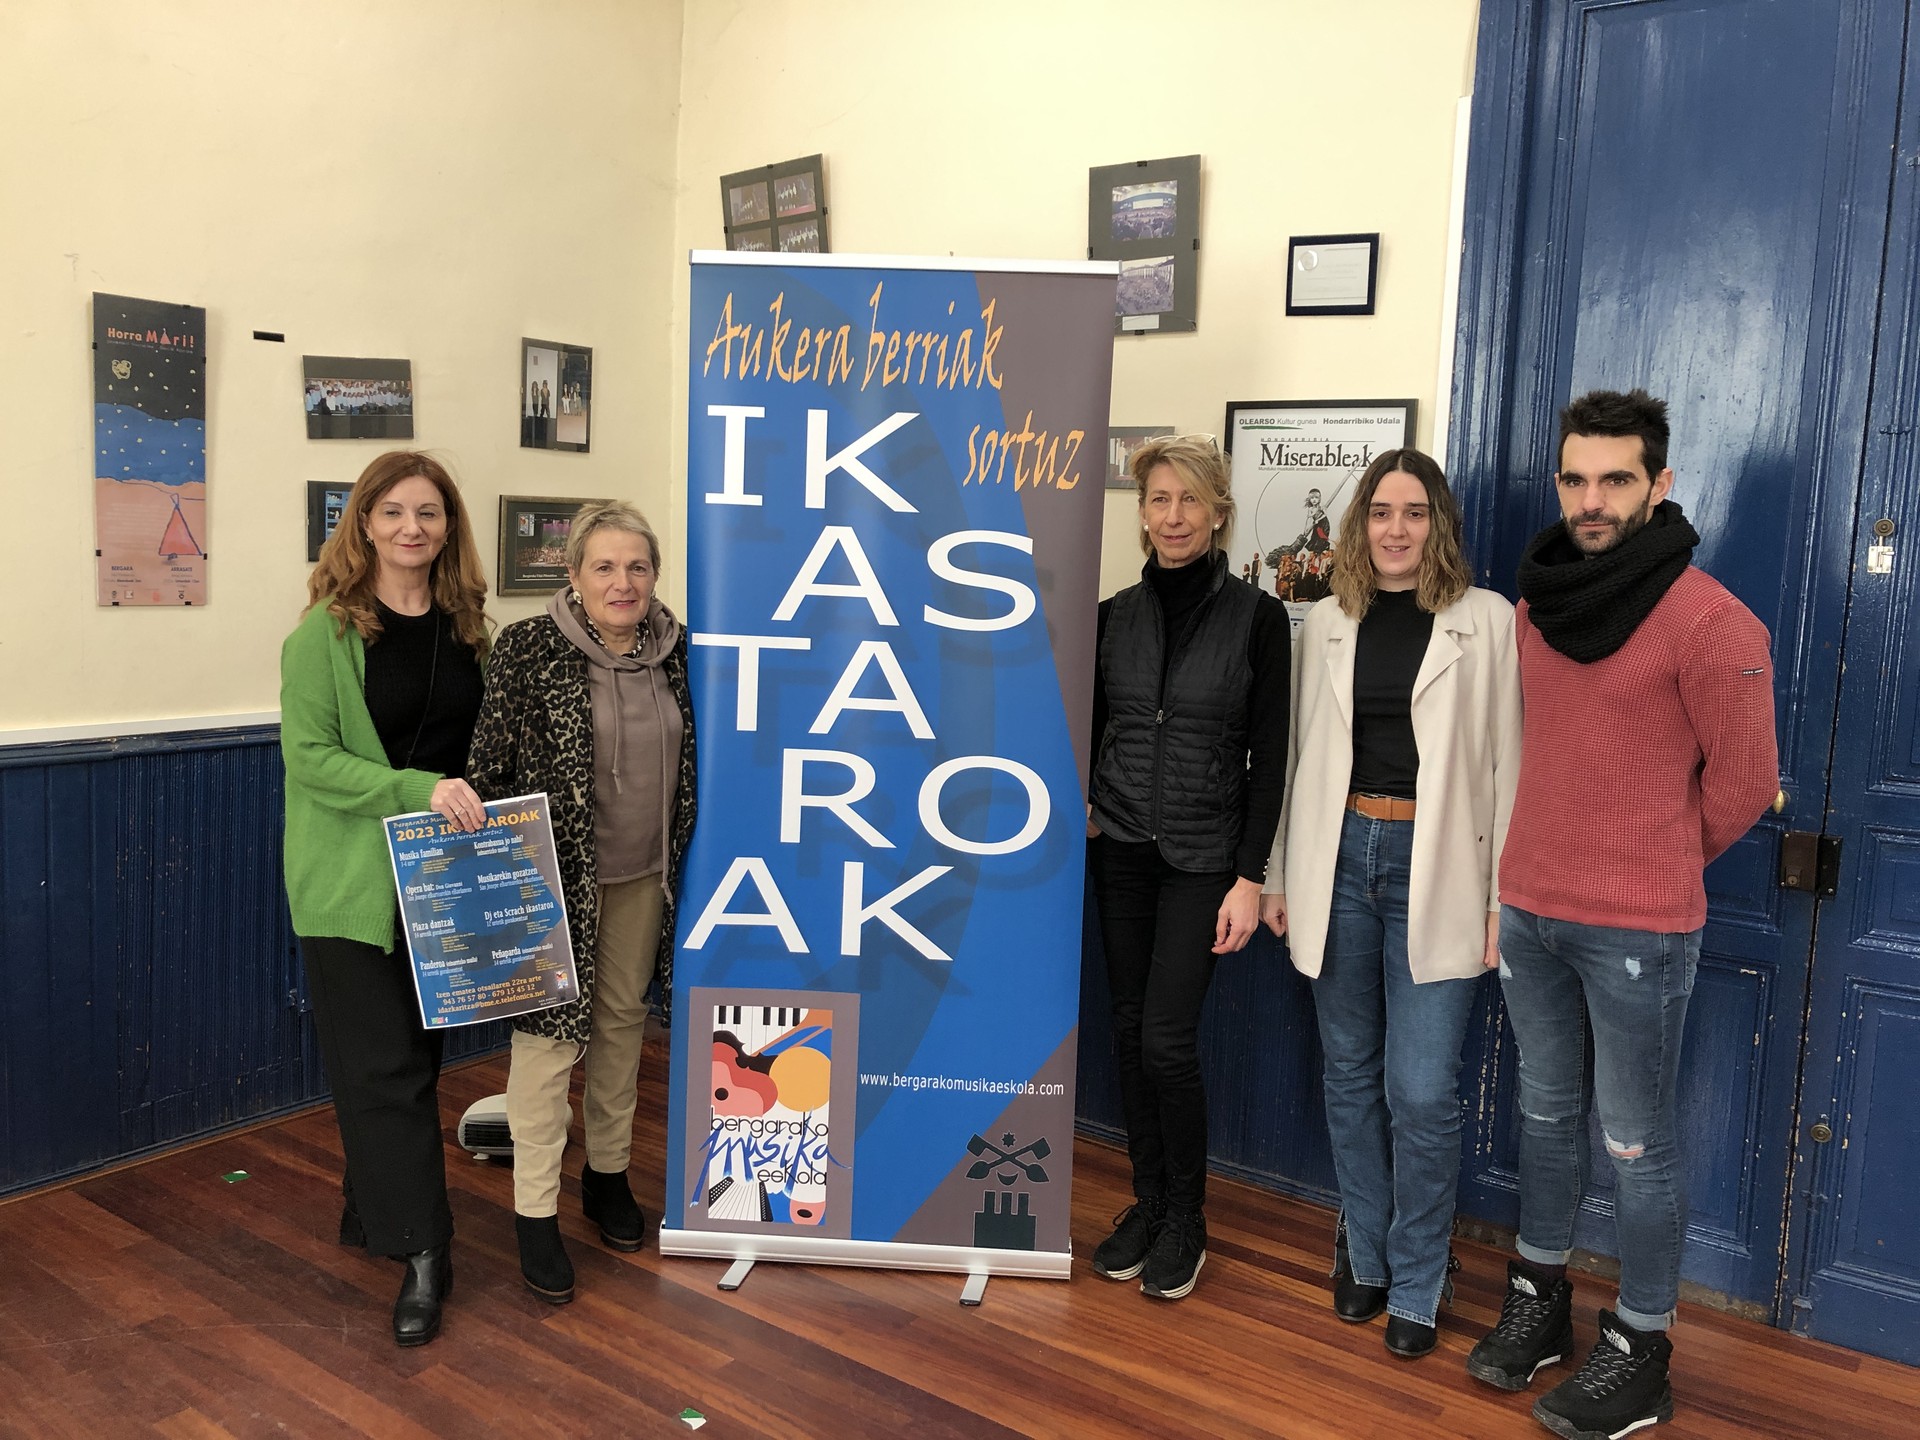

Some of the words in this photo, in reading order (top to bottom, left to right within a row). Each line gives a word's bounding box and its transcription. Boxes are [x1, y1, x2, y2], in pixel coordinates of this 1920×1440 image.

[107, 327, 142, 341] Horra
[704, 292, 854, 386] Aukera
[861, 281, 1003, 392] berriak
[1323, 417, 1374, 425] Hondarribiko
[1376, 417, 1401, 425] Udala
[963, 410, 1085, 492] sortuz
[1260, 443, 1373, 467] Miserableak
[396, 826, 434, 842] 2023
[428, 836, 455, 844] Aukera
[482, 829, 503, 837] sortuz
[477, 871, 511, 883] Musikarekin
[512, 867, 538, 880] gozatzen
[405, 885, 423, 895] Opera
[484, 911, 493, 921] Dj
[493, 910, 503, 919] eta
[504, 906, 525, 917] Scrach
[525, 901, 554, 914] ikastaroa
[412, 922, 429, 932] Plaza
[429, 917, 455, 929] dantzak
[419, 960, 445, 970] Panderoa
[436, 991, 451, 999] Izen
[451, 988, 476, 997] ematea
[477, 981, 511, 993] otsailaren
[528, 975, 542, 983] arte
[442, 998, 456, 1006] 943
[457, 996, 466, 1004] 76
[477, 992, 487, 1000] 80
[492, 989, 505, 997] 679
[506, 987, 515, 995] 15
[516, 985, 525, 993] 45
[527, 983, 535, 991] 12
[860, 1072, 1064, 1096] www.bergarakomusikaeskola.com
[710, 1106, 829, 1138] bergarako
[757, 1160, 828, 1186] eskola
